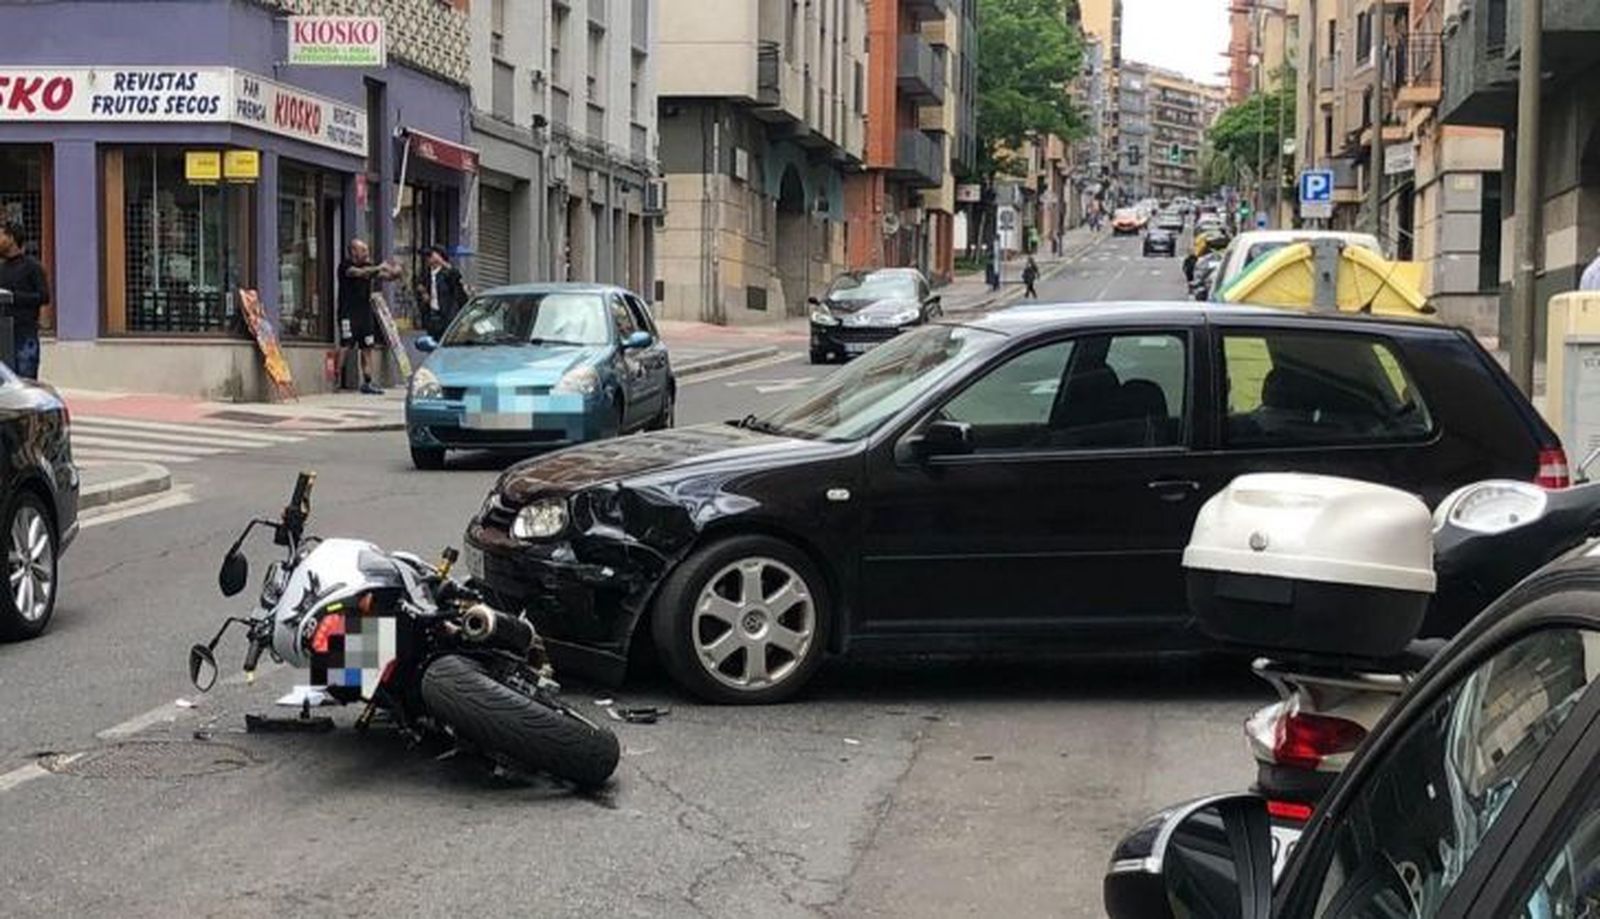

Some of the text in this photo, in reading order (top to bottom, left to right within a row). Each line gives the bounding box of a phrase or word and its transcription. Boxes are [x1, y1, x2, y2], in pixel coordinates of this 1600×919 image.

[295, 21, 378, 44] KIOSKO
[114, 72, 198, 92] REVISTAS
[92, 95, 220, 115] FRUTOS SECOS
[274, 91, 322, 135] KIOSKO
[1306, 175, 1327, 199] P
